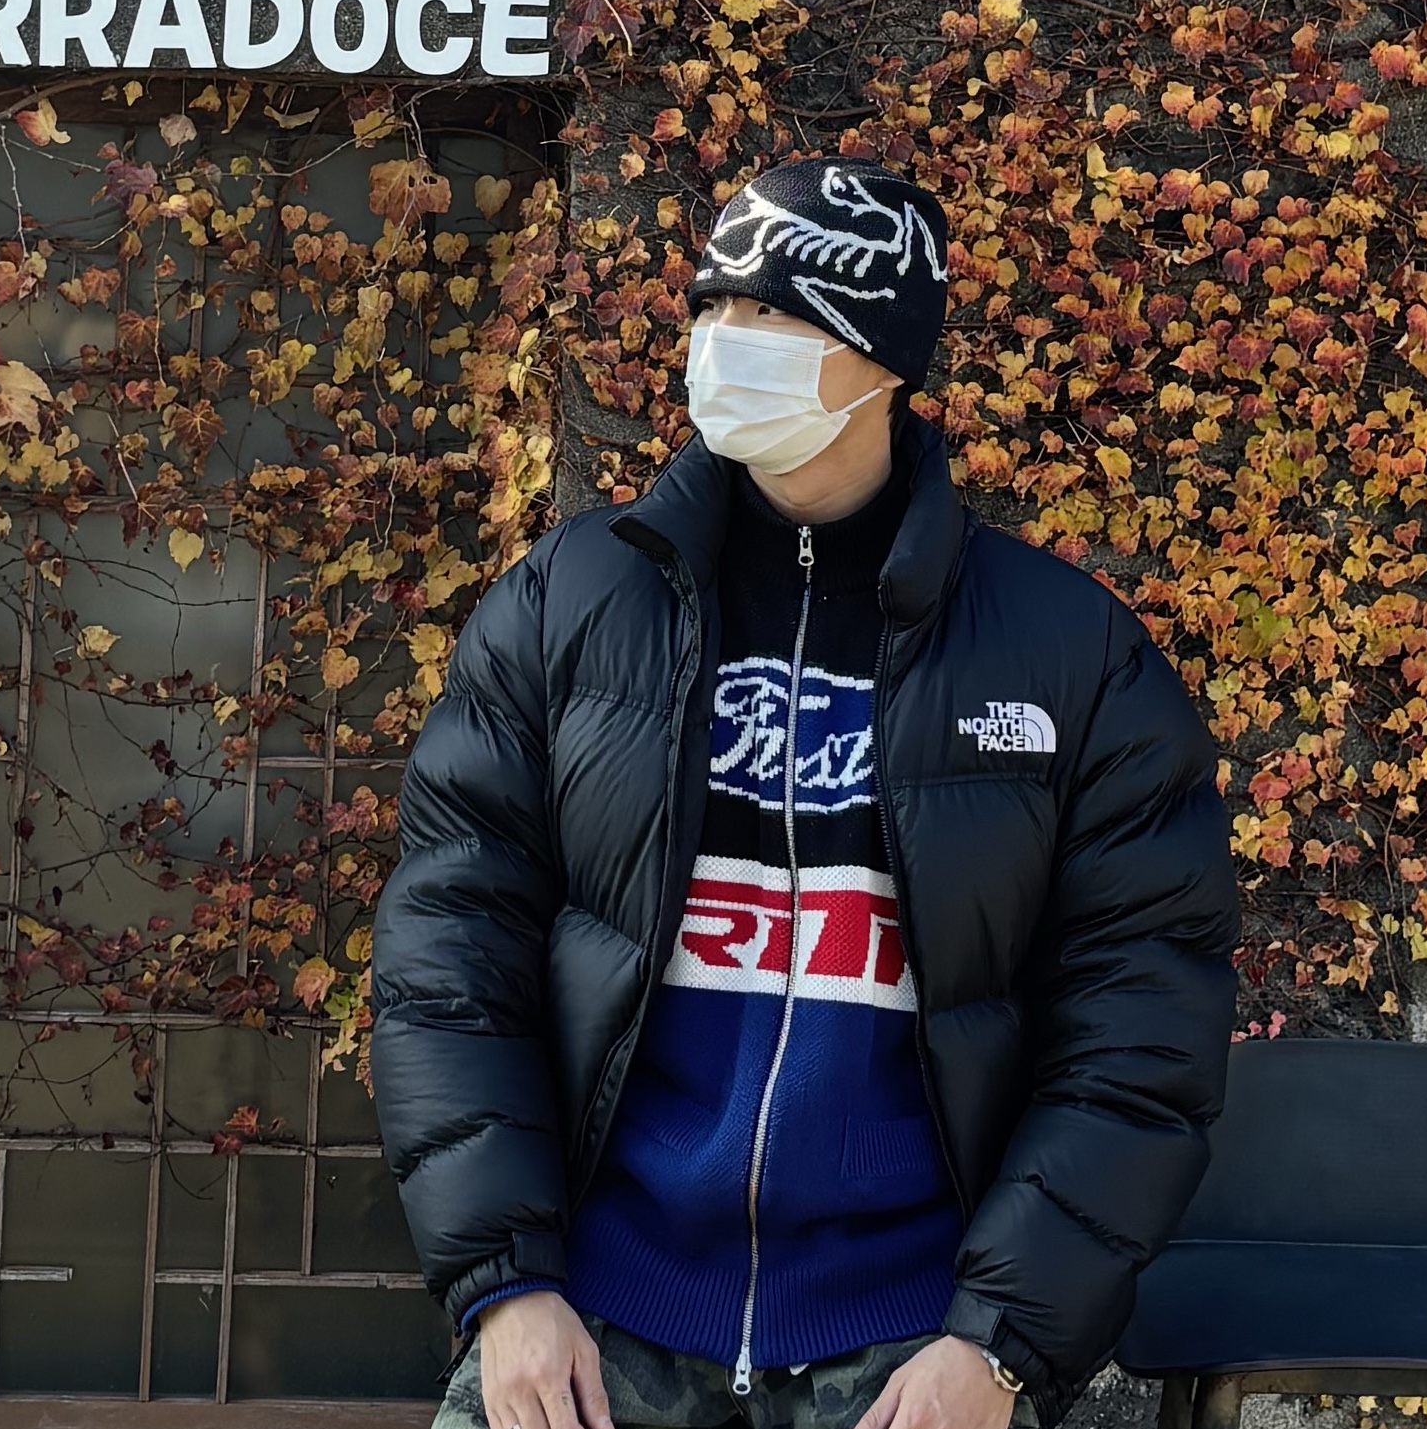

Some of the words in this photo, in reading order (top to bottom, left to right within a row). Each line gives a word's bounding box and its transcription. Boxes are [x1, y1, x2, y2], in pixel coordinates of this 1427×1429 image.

[985, 701, 1024, 718] THE
[957, 717, 1024, 735] NORTH
[977, 734, 1026, 752] FACE
